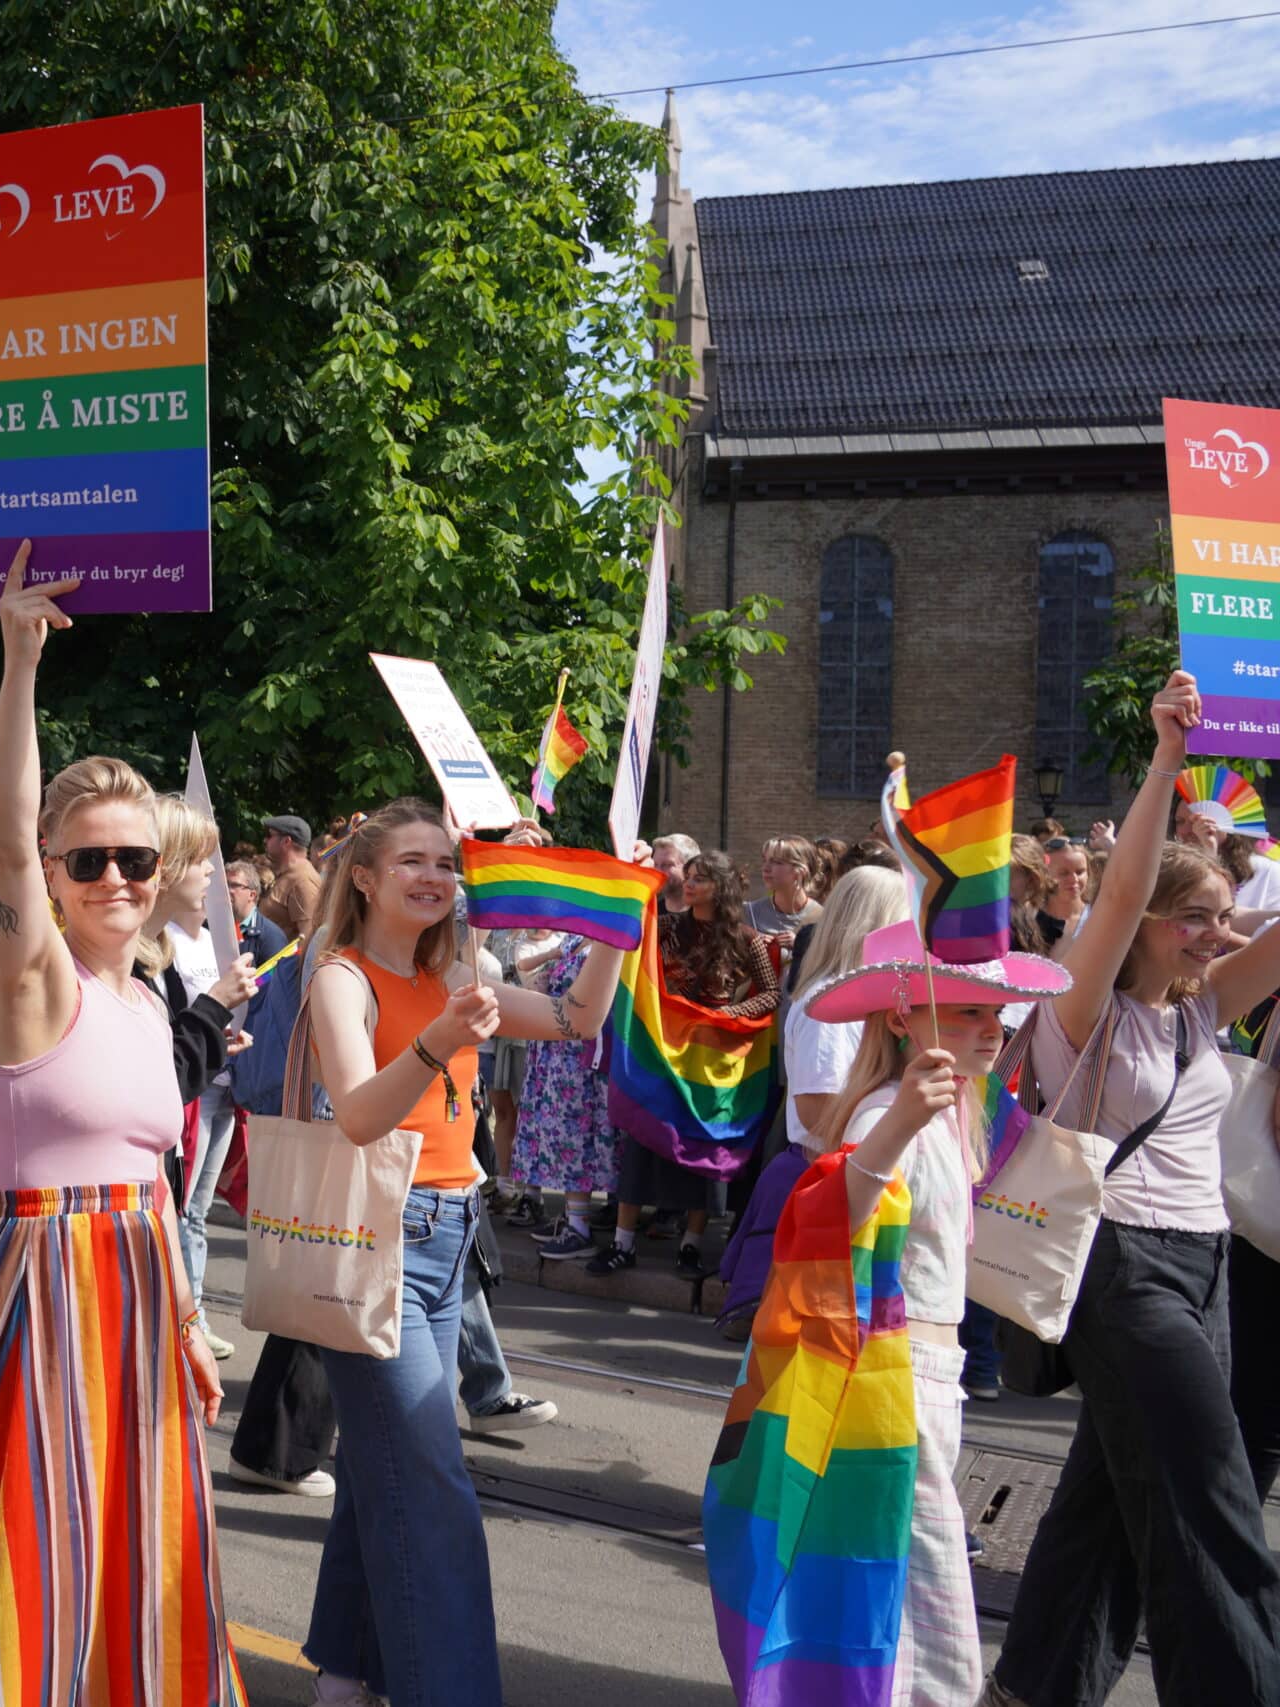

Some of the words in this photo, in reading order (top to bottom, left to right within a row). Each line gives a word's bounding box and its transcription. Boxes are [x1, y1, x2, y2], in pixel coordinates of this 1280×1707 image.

[53, 185, 135, 223] LEVE
[59, 314, 177, 354] INGEN
[37, 390, 60, 430] Å
[72, 390, 189, 428] MISTE
[1188, 448, 1248, 473] LEVE
[1191, 539, 1223, 562] VI
[61, 566, 86, 581] når
[90, 567, 109, 580] du
[114, 566, 148, 584] bryr
[152, 565, 185, 584] deg!
[1190, 592, 1273, 620] FLERE
[1203, 719, 1220, 730] Du
[1223, 722, 1236, 731] er
[1239, 720, 1264, 733] ikke
[250, 1208, 377, 1251] #psyktstolt
[973, 1256, 1030, 1281] mentalhelse.no
